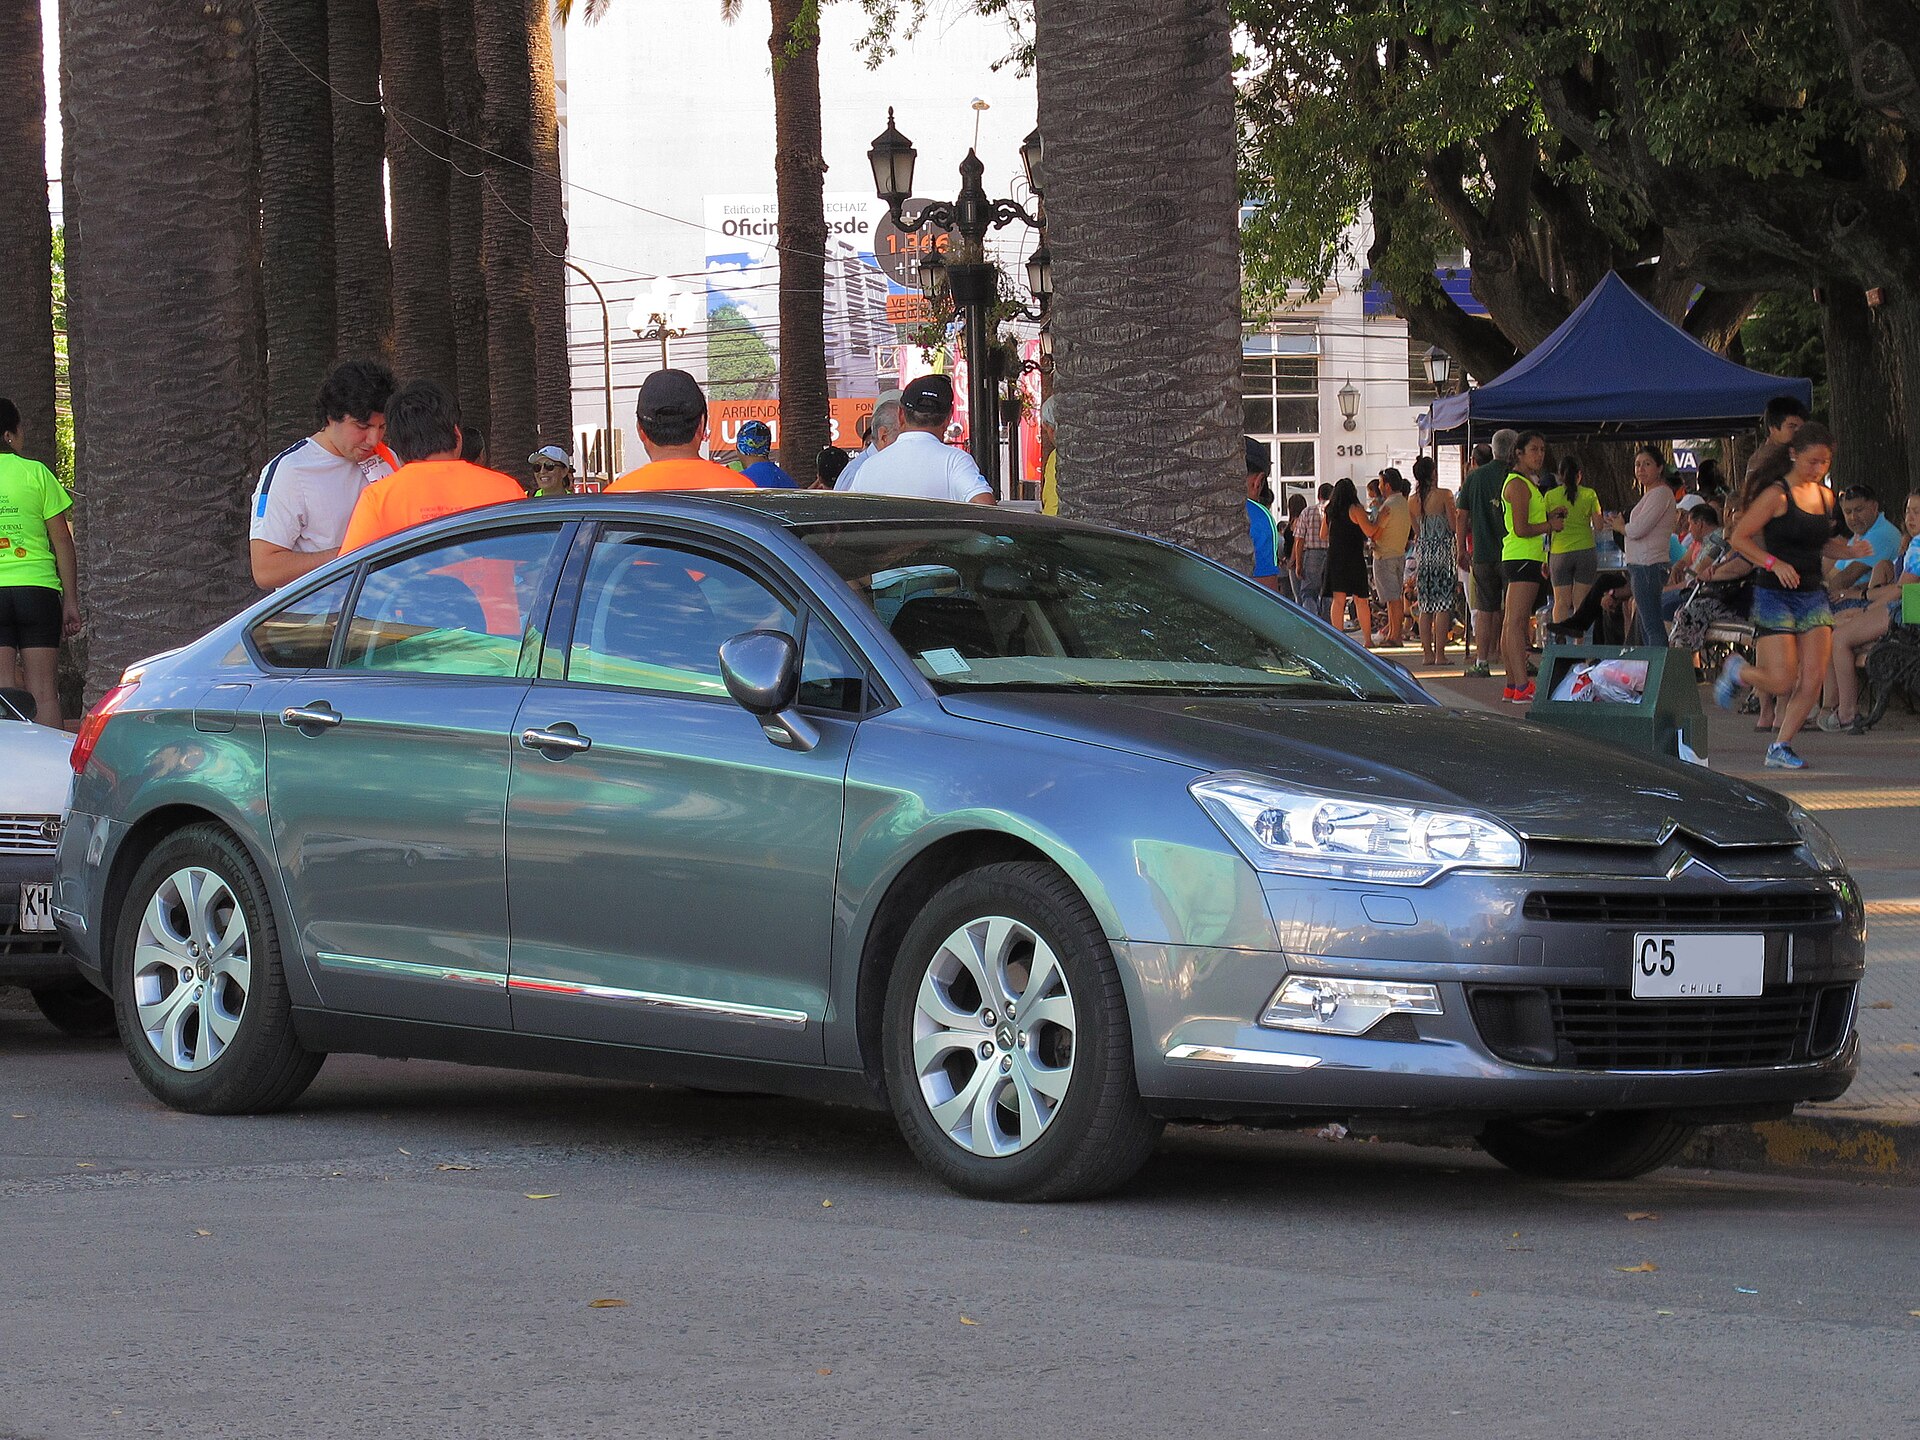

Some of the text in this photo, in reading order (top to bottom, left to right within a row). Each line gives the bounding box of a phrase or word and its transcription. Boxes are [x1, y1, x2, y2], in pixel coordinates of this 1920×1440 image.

[723, 202, 868, 215] Edificio RE ECHAIZ
[722, 216, 869, 236] Oficin esde
[855, 403, 874, 411] FON
[1336, 444, 1364, 457] 318
[1673, 452, 1697, 469] VA
[1640, 938, 1675, 977] C5
[1680, 983, 1723, 994] CHILE
